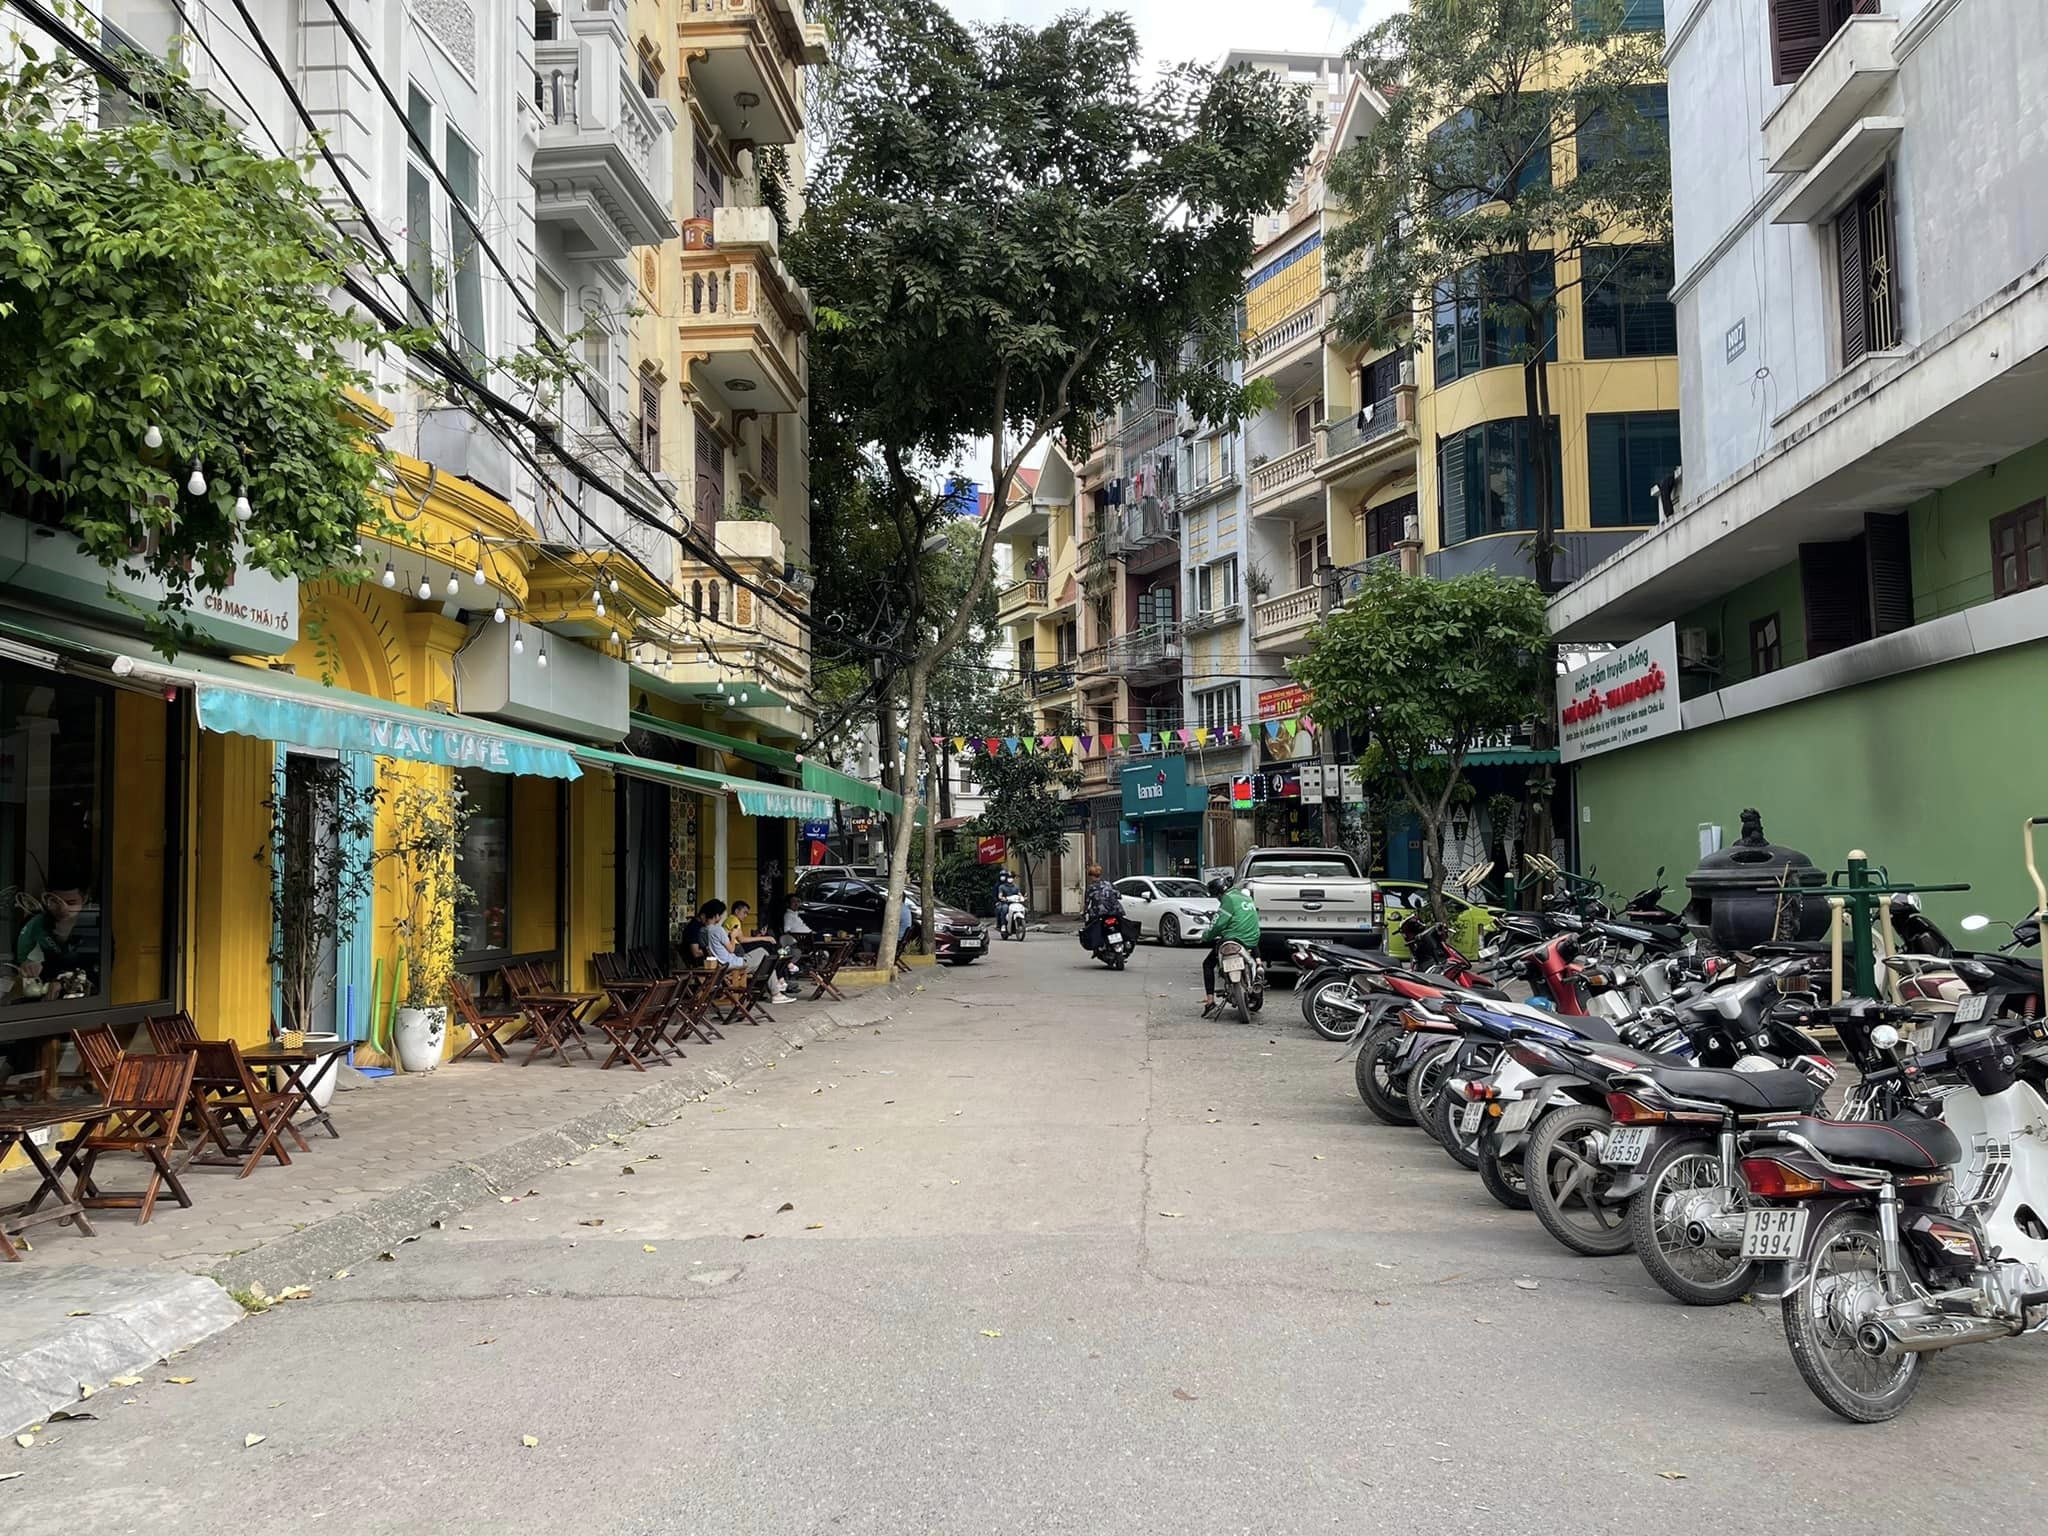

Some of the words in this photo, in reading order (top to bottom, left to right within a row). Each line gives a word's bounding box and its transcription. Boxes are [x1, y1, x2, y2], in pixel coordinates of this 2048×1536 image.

[205, 594, 222, 610] C18
[224, 600, 248, 619] MẠC
[251, 608, 273, 628] THÁI
[1628, 646, 1649, 669] thống
[1258, 915, 1368, 923] RANGER
[1612, 1129, 1643, 1145] 29-H1
[1604, 1145, 1641, 1162] 485.58
[1754, 1211, 1797, 1233] 19-R1
[1748, 1234, 1792, 1256] 3994
